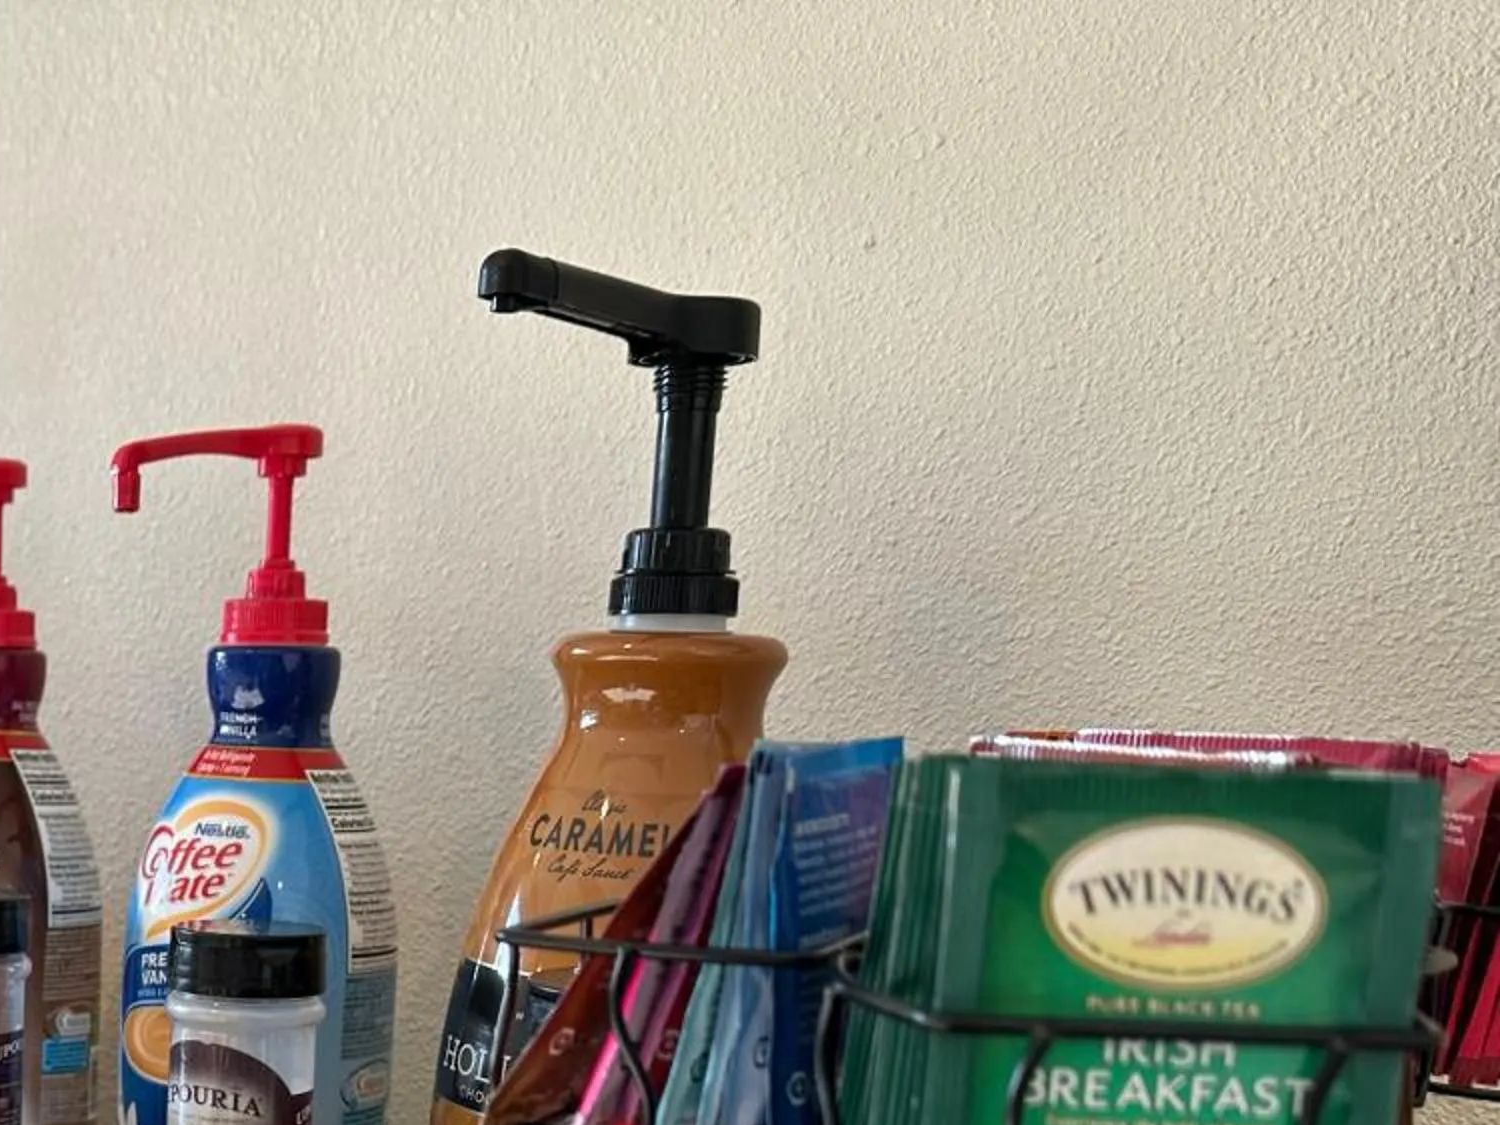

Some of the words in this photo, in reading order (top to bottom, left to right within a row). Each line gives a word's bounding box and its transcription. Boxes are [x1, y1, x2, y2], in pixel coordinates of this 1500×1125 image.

[141, 824, 244, 879] Coffee
[1068, 866, 1298, 924] TWININGS
[1147, 996, 1215, 1017] BLACK
[1103, 1037, 1237, 1068] IRISH
[1023, 1066, 1316, 1118] BREAKFAST
